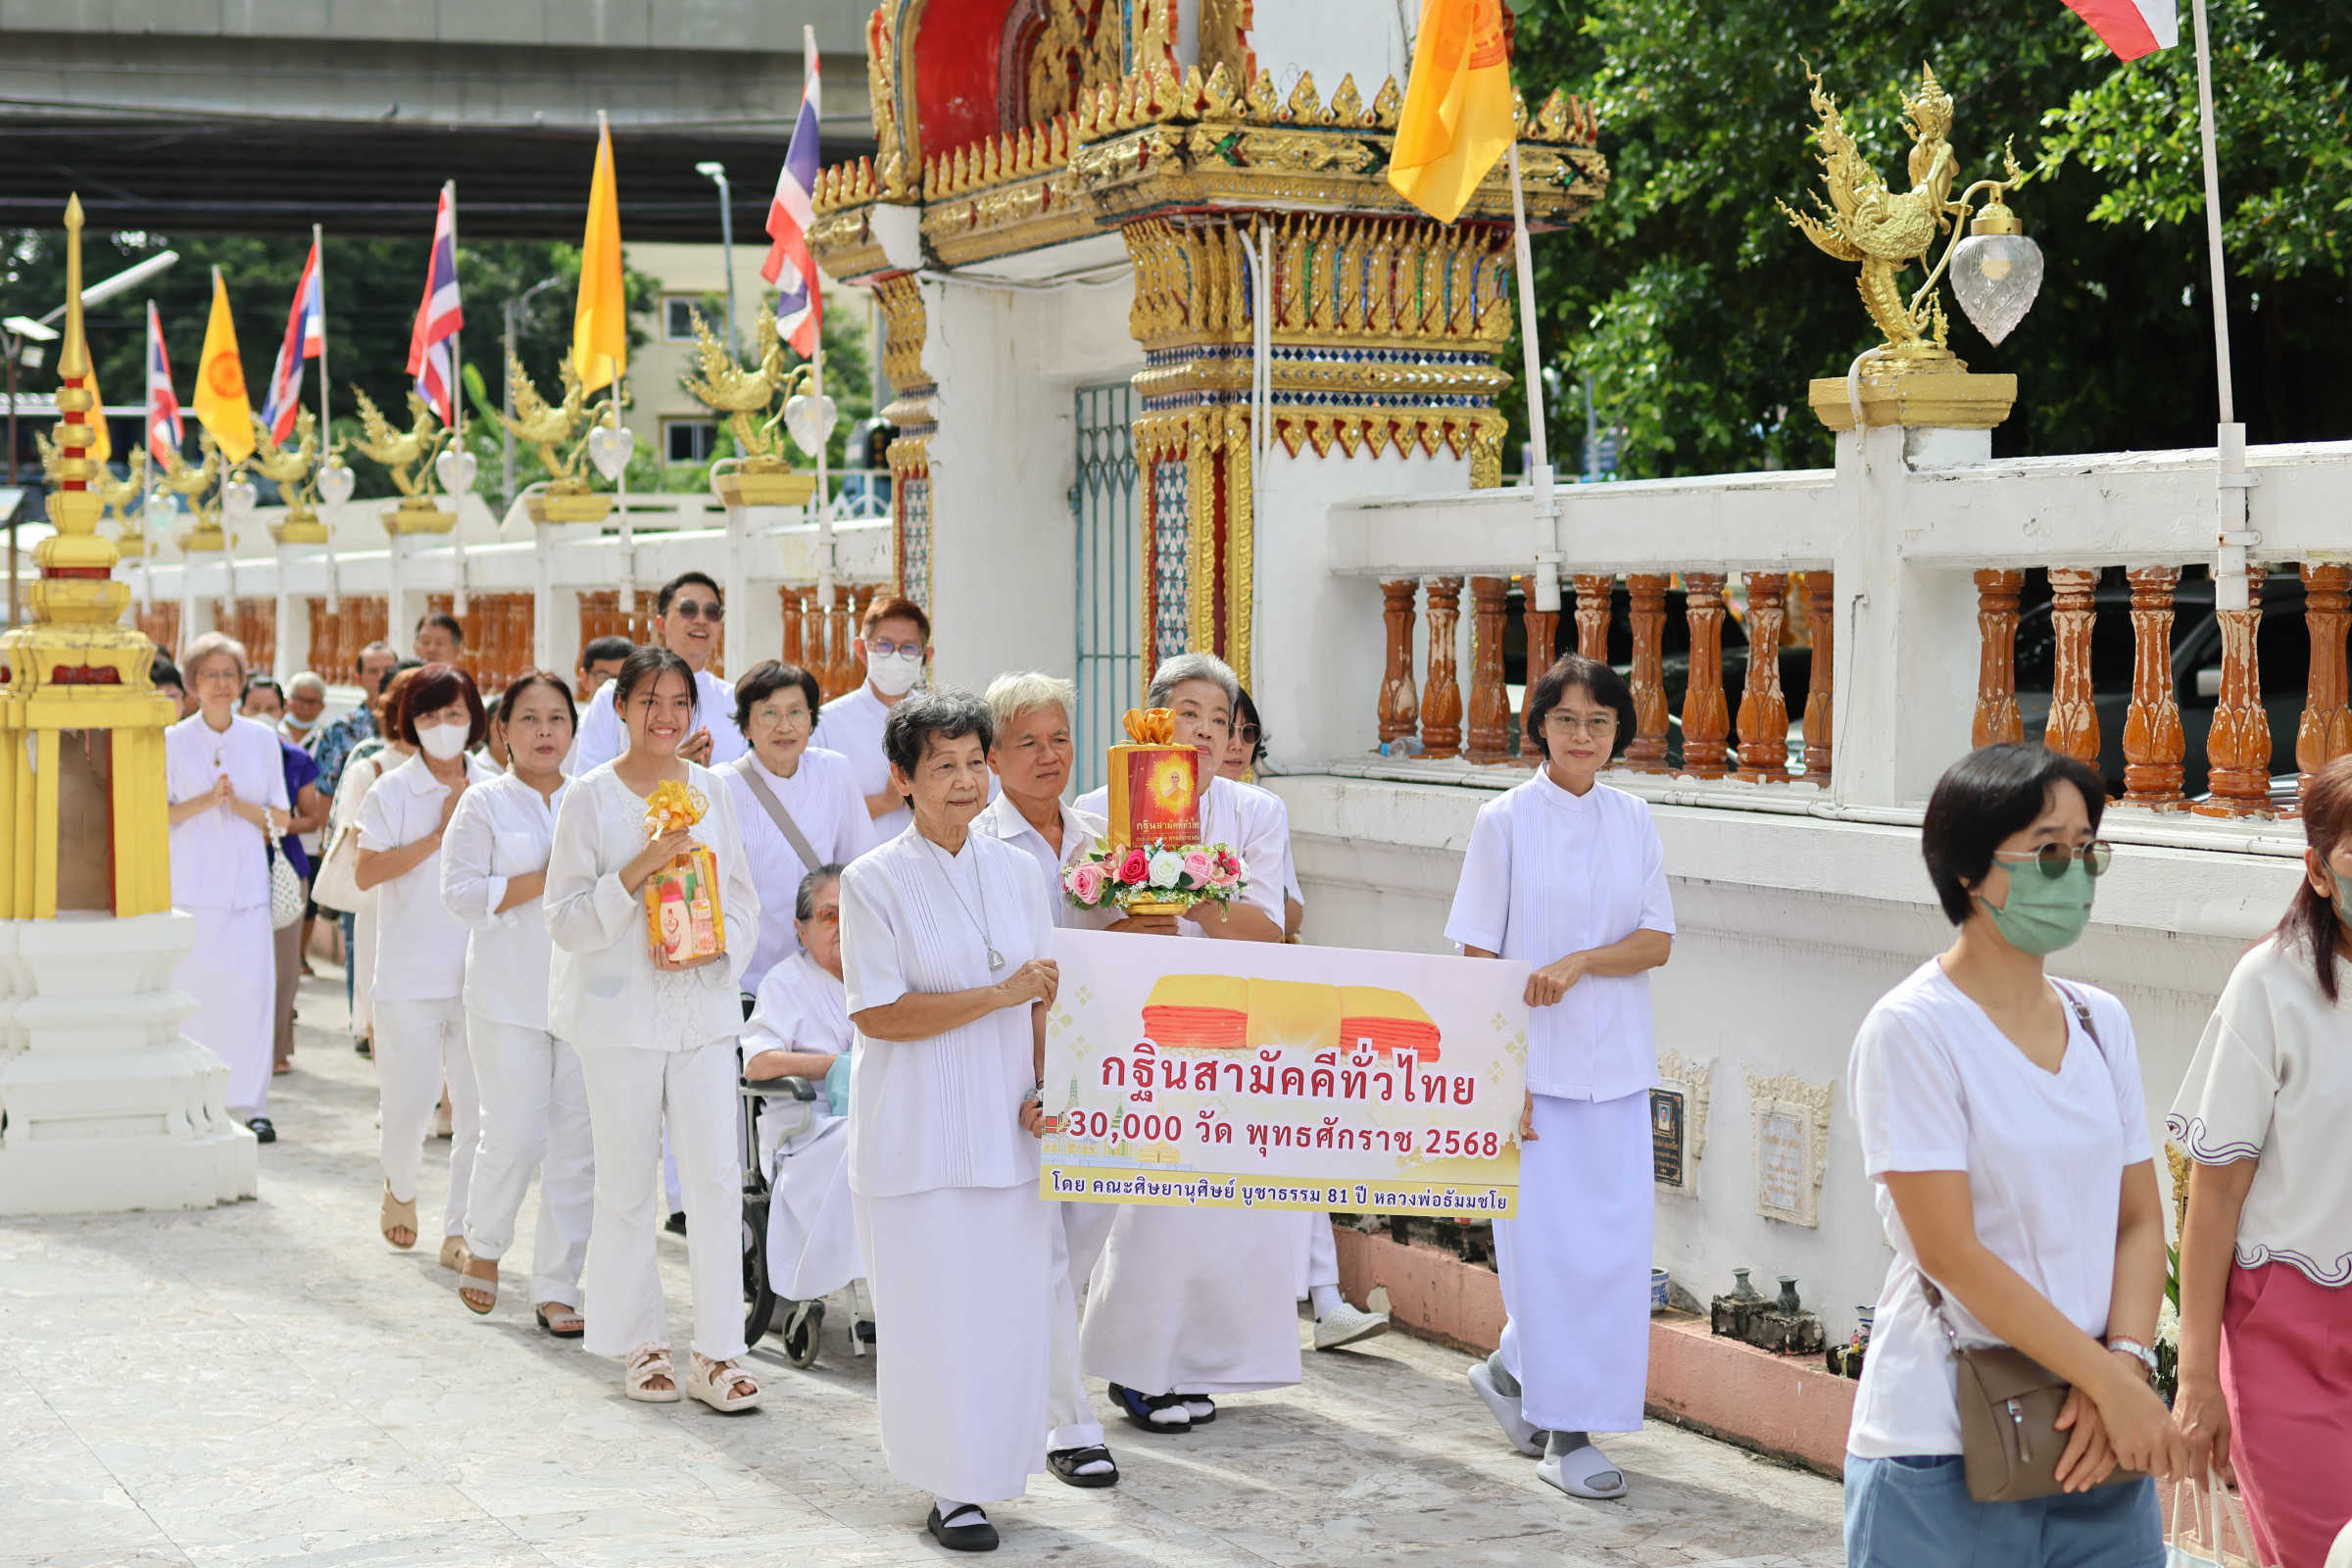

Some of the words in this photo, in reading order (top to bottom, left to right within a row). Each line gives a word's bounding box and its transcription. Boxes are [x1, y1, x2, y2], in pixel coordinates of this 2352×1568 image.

[1102, 1043, 1475, 1105] กฐินสามัคคีทั่วไทย
[1069, 1110, 1182, 1145] 30,000
[1195, 1109, 1233, 1144] วัด
[1246, 1116, 1413, 1158] พุทธศักราช
[1425, 1128, 1498, 1157] 2568
[1052, 1170, 1085, 1193] โดย
[1093, 1176, 1236, 1203] คณะศิษยานุศิษย์
[1241, 1186, 1321, 1206] บูชาธรรม
[1327, 1188, 1348, 1204] 81
[1354, 1185, 1367, 1204] ปี
[1373, 1188, 1507, 1210] หลวงพ่อธัมมชโย
